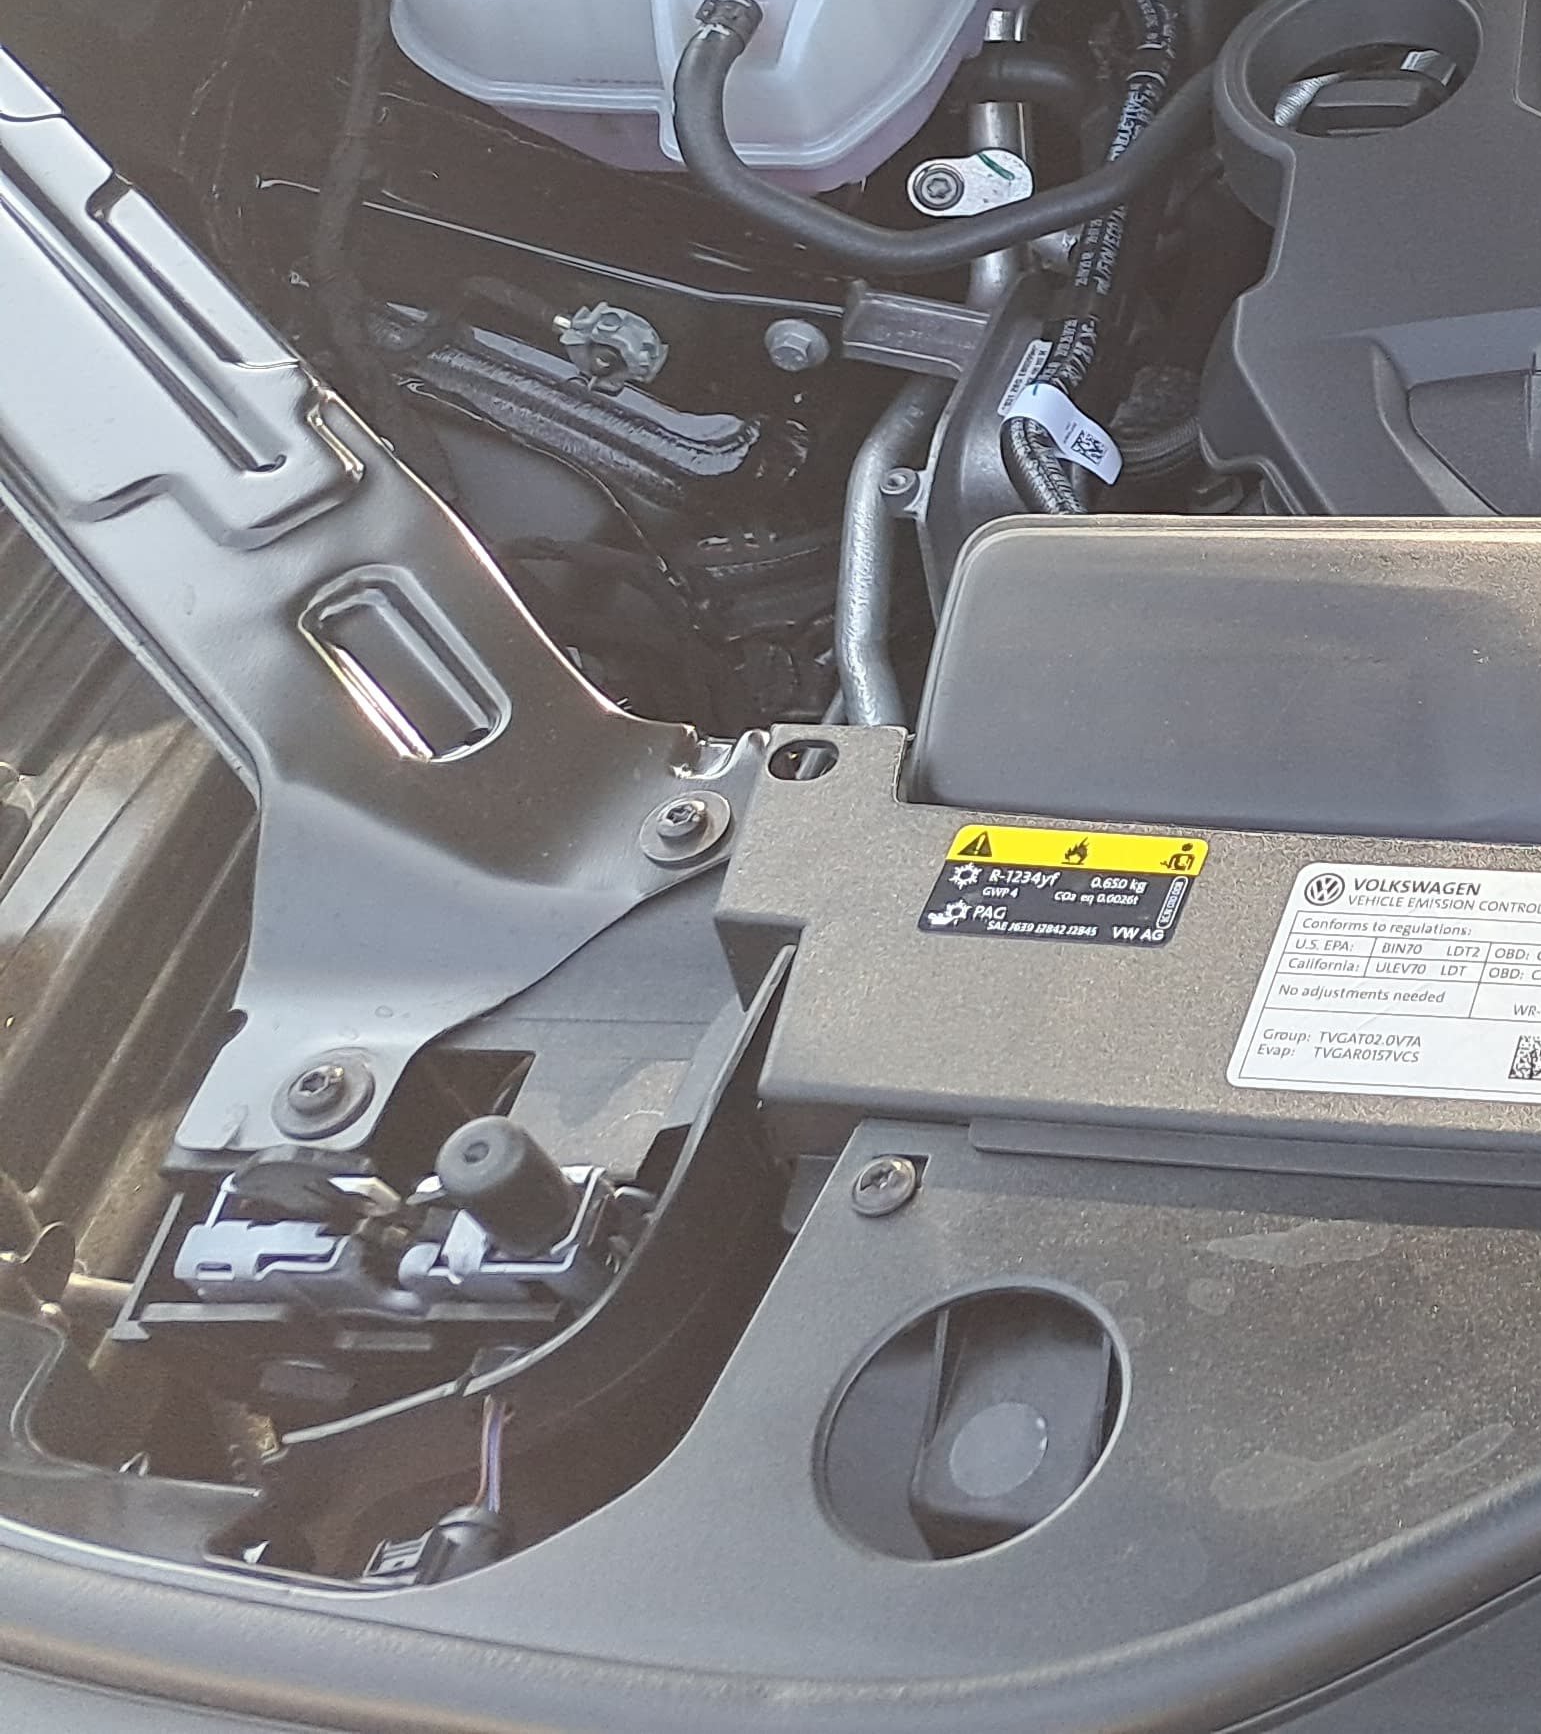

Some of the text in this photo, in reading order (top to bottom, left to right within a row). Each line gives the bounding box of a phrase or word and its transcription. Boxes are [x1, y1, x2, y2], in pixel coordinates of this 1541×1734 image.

[988, 868, 1060, 888] R-1234yf
[1090, 876, 1147, 894] 0.650 kg
[982, 886, 1019, 898] GWP 4
[1354, 878, 1481, 896] VOLKSWAGEN
[972, 904, 1007, 920] PAG
[1348, 894, 1404, 908] VEHICLE
[1407, 896, 1475, 910] EMISSION
[1478, 900, 1541, 915] CONTROL
[986, 919, 1009, 931] SAE
[1302, 917, 1472, 937] Conforms to regulations:
[1112, 926, 1164, 941] VW AG
[1294, 938, 1354, 952] U.S. EPA:
[1381, 942, 1481, 958] BIN70 LDT2
[1494, 947, 1530, 960] OBD:
[1288, 957, 1360, 972] California:
[1375, 961, 1467, 977] ULEV70 LDT
[1488, 966, 1524, 980] OBD:
[1278, 983, 1446, 1003] No adjustments needed
[1262, 1028, 1311, 1044] Group:
[1256, 1042, 1419, 1063] Evap: TVGAR0157VCS
